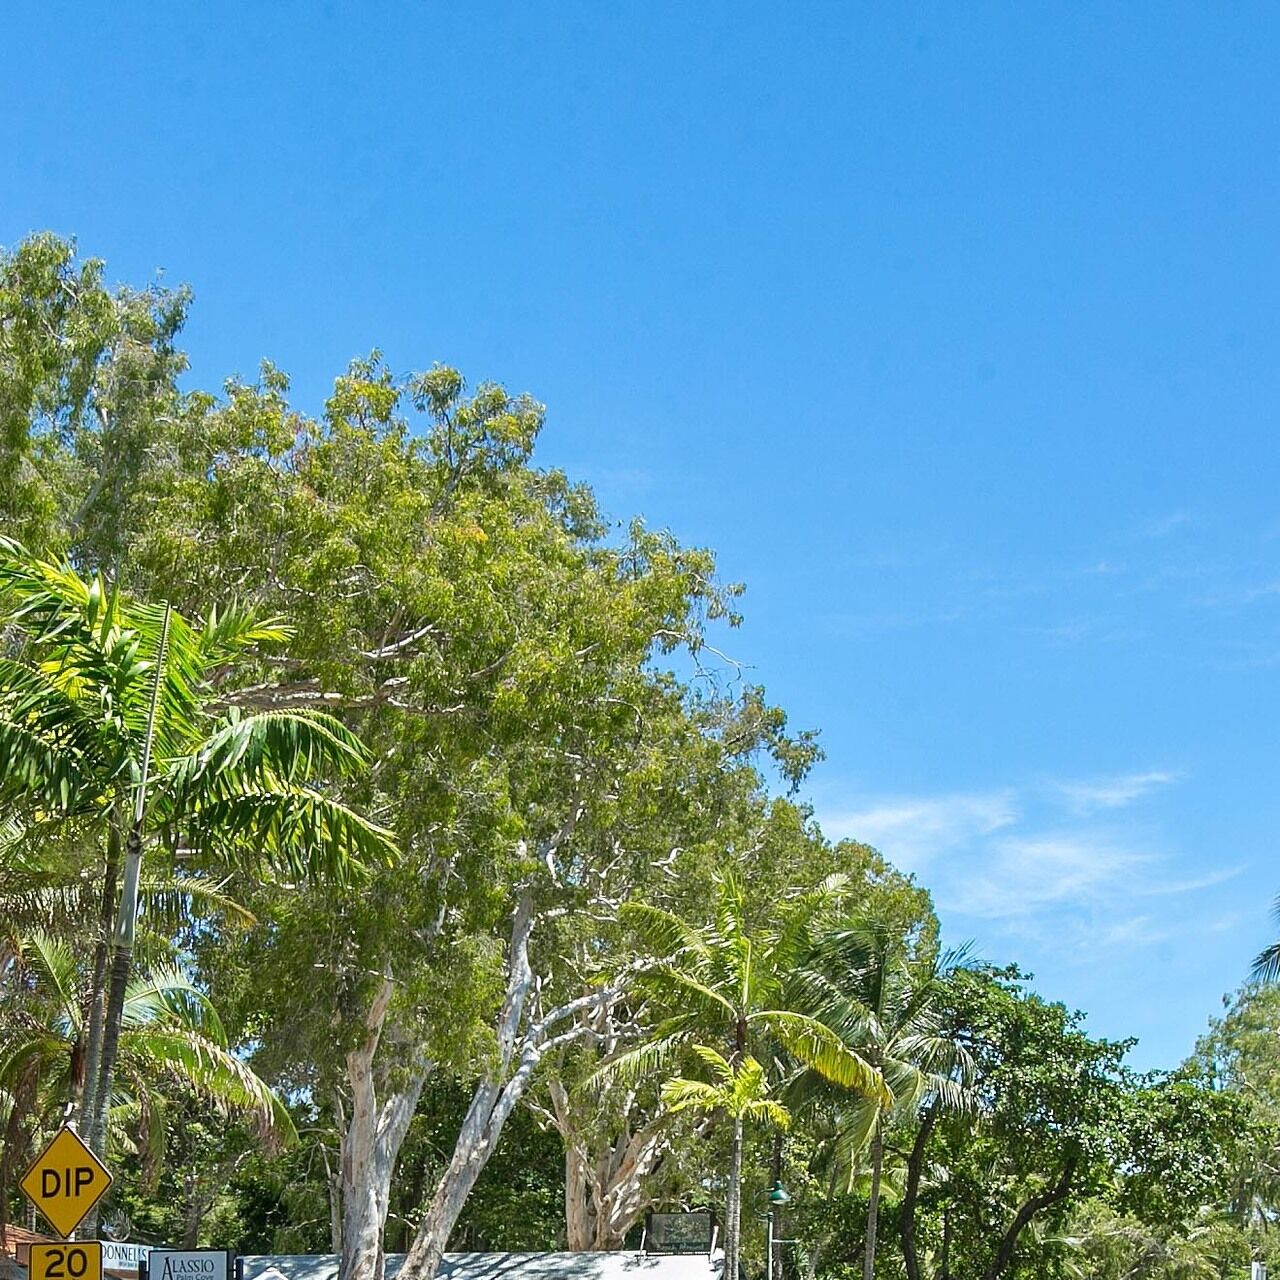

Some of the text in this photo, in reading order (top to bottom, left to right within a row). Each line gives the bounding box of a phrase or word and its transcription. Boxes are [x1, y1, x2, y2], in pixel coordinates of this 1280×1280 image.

[41, 1167, 95, 1199] DIP
[44, 1248, 88, 1278] 20
[176, 1273, 214, 1280] Palm Cove
